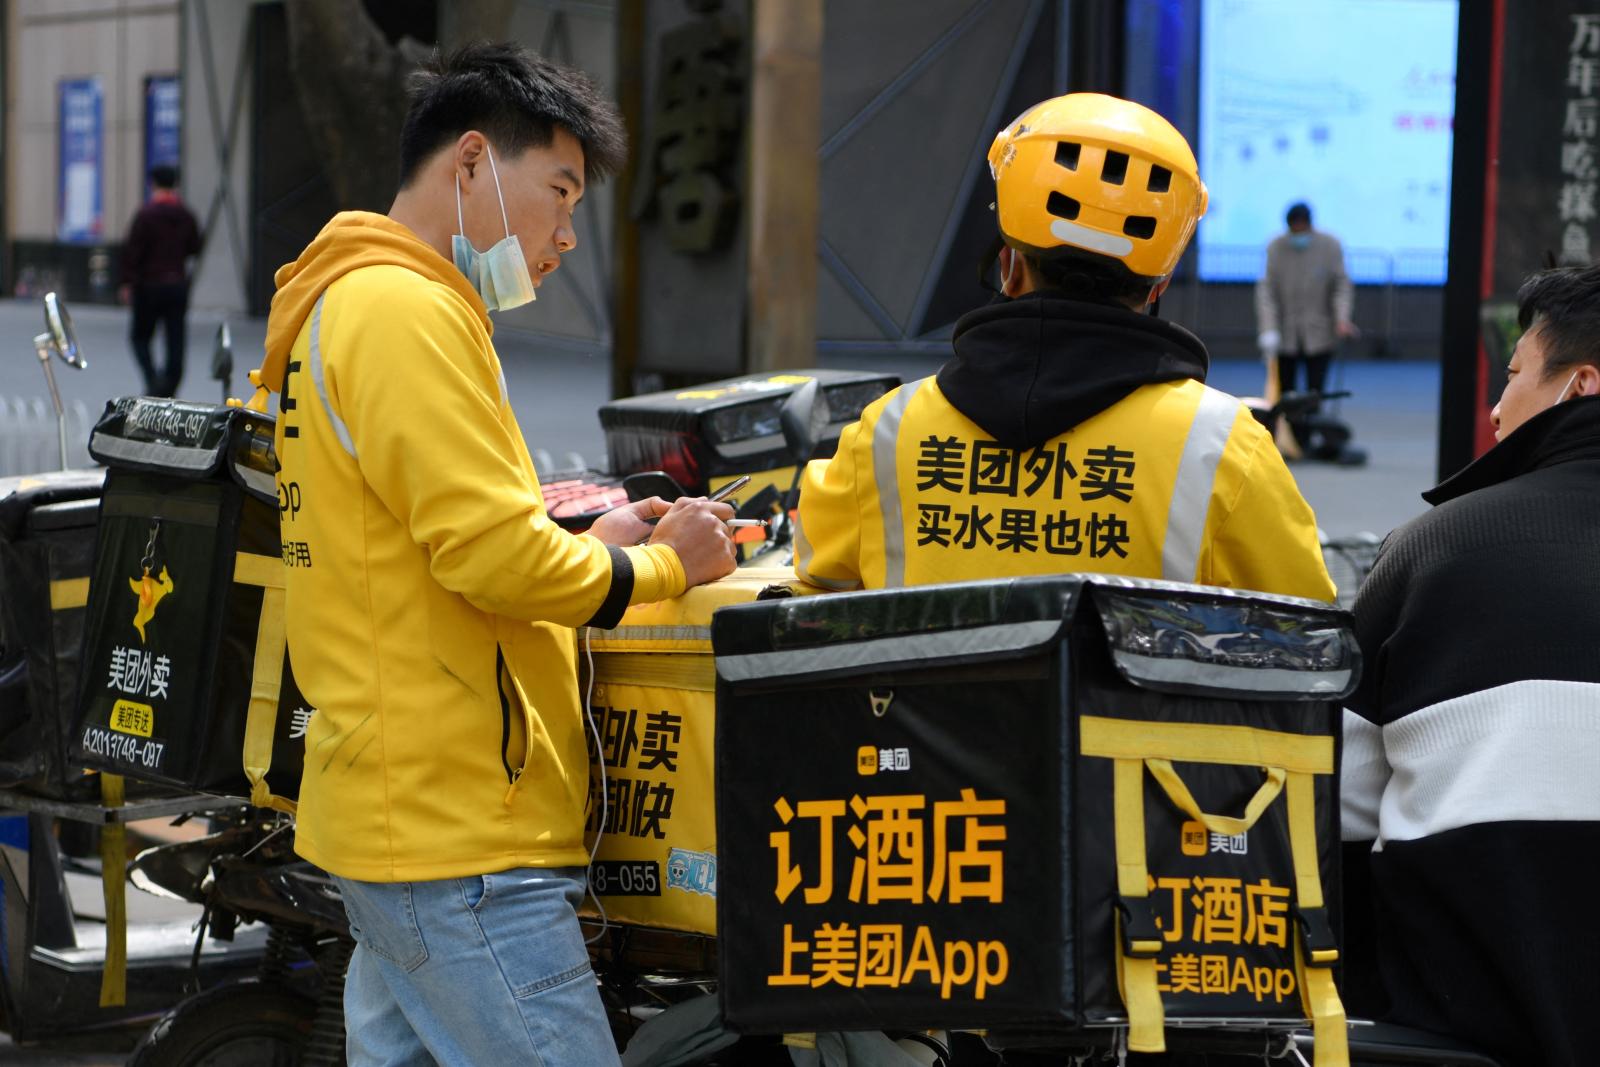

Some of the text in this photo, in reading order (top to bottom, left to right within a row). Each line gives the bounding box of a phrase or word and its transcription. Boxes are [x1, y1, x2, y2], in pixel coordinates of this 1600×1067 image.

[917, 435, 1135, 503] 美团外卖
[917, 504, 1130, 558] 买水果也快
[107, 645, 171, 700] 美团外卖
[116, 705, 149, 733] 美团专送
[83, 727, 163, 768] A2013748-097
[879, 747, 911, 771] 美团
[585, 776, 675, 839] 都快
[769, 788, 1007, 904] 订酒店
[588, 865, 657, 893] 8-055
[767, 922, 1009, 999] 上美团App
